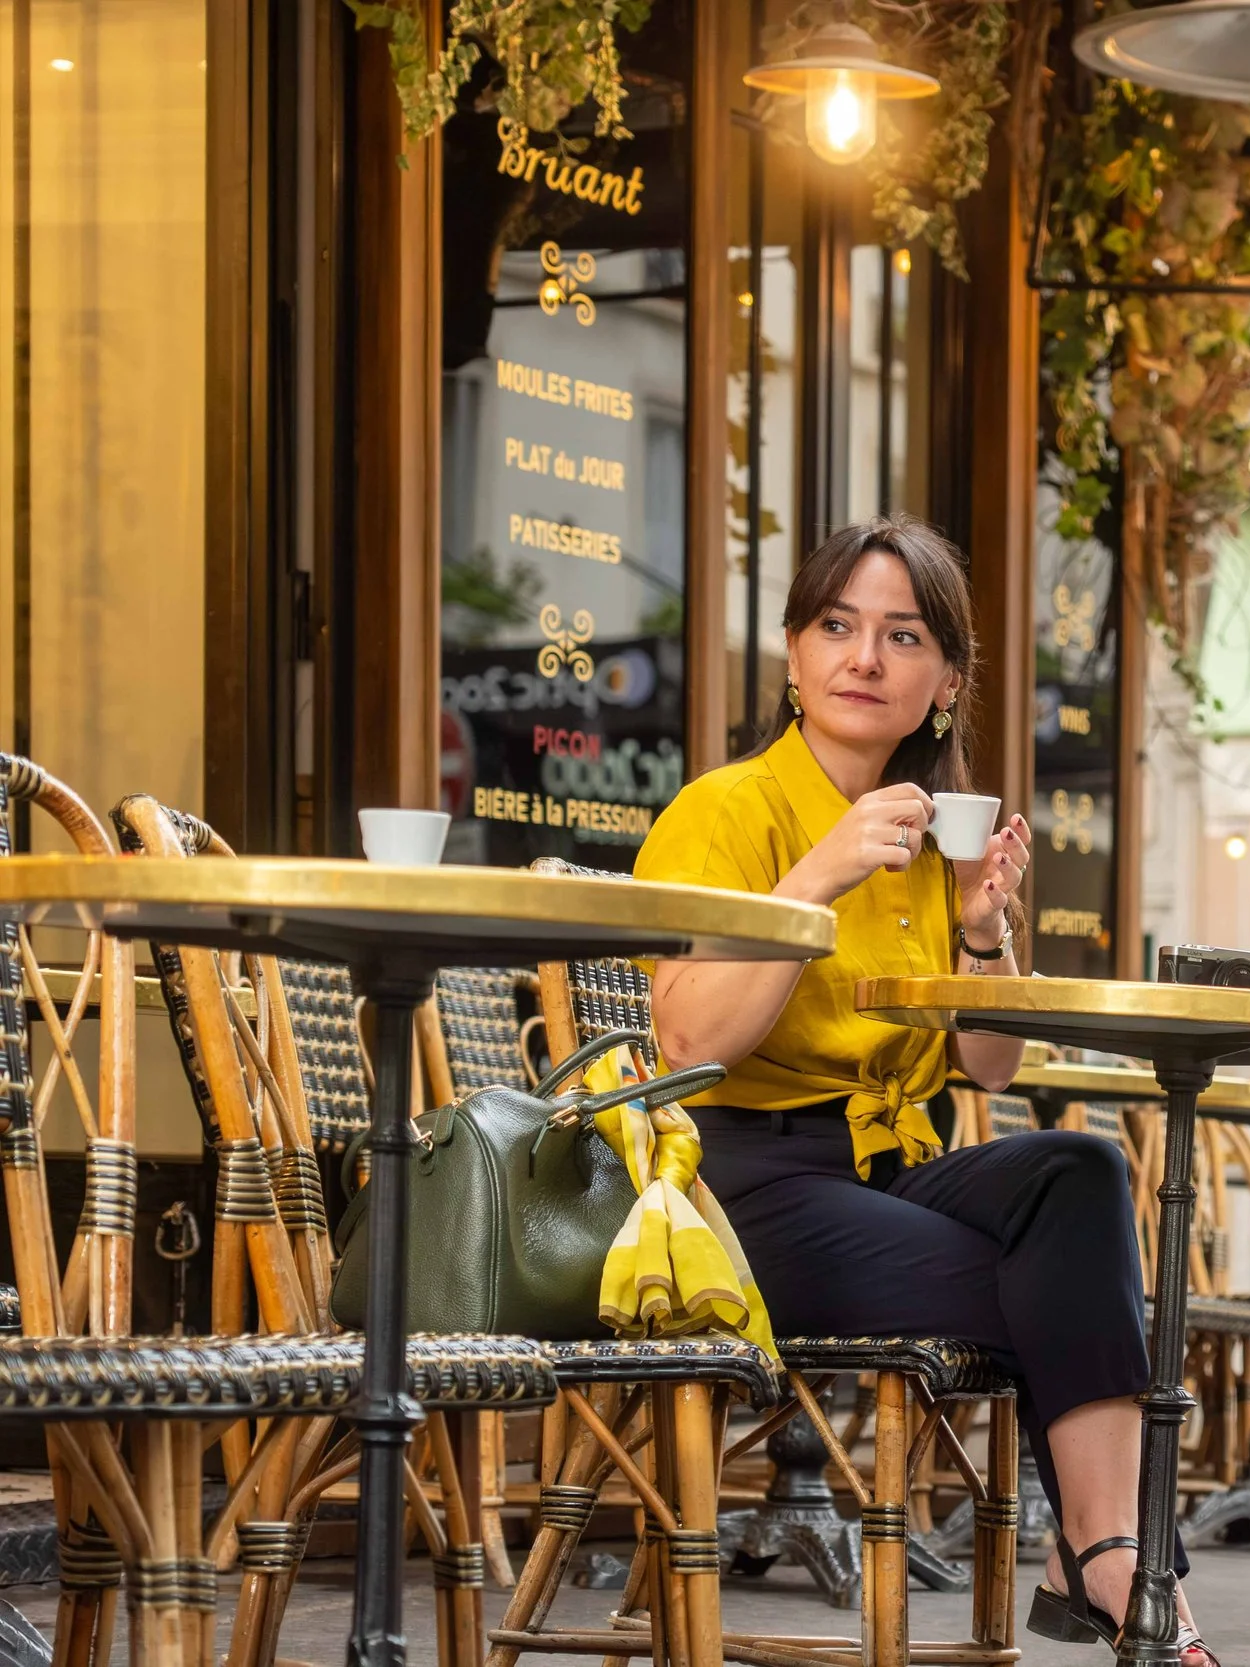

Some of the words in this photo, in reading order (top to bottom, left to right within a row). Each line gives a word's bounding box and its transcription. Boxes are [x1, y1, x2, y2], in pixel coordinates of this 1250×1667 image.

[497, 116, 645, 216] Bruant
[497, 359, 572, 406] MOULES
[574, 380, 634, 421] FRITES
[505, 437, 552, 475] PLAT
[554, 451, 576, 481] du
[579, 456, 625, 491] JOUR
[509, 513, 622, 564] PATISSERIES
[533, 724, 601, 762] PICON
[546, 795, 564, 827] la
[566, 798, 653, 837] PRESSION
